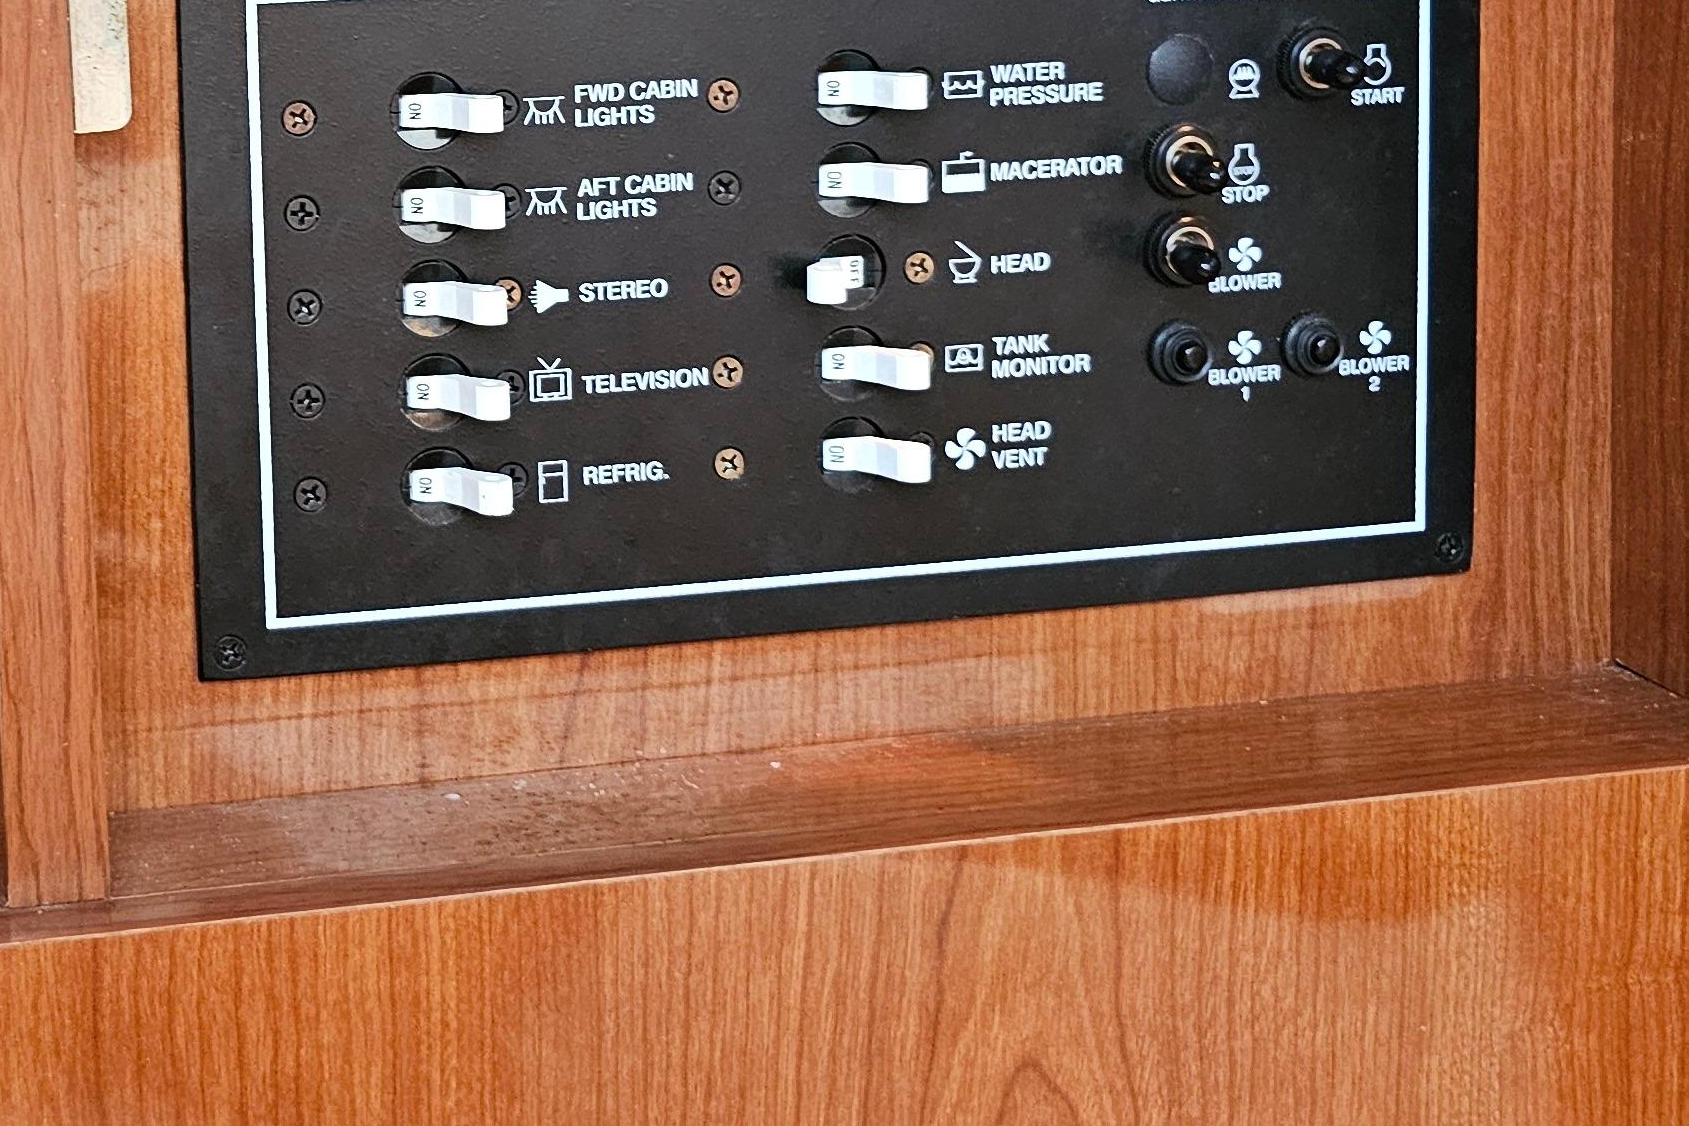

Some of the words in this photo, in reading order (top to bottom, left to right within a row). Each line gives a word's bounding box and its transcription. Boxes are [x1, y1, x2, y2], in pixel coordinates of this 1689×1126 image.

[990, 61, 1066, 84] WATER
[574, 82, 625, 104] FWD
[629, 78, 699, 101] CABIN
[989, 81, 1105, 107] PRESSURE
[1350, 86, 1405, 107] START
[408, 102, 422, 120] ON
[574, 104, 655, 128] LIGHTS
[990, 154, 1124, 182] MACERATOR
[577, 176, 620, 198] AFT
[624, 172, 694, 196] CABIN
[1221, 184, 1271, 205] STOP
[410, 197, 424, 214] ON
[576, 197, 658, 221] LIGHTS
[990, 251, 1051, 275] HEAD
[578, 278, 669, 303] STEREO
[991, 333, 1050, 356] TANK
[991, 353, 1092, 379] MONITOR
[1207, 364, 1281, 386] BLOWER
[1338, 354, 1410, 376] BLOWER
[581, 367, 710, 395] TELEVISION
[1368, 375, 1381, 393] 2
[1240, 385, 1251, 403] 1
[991, 420, 1052, 444] HEAD
[991, 447, 1049, 470] VENT
[582, 460, 671, 486] REFRIG.
